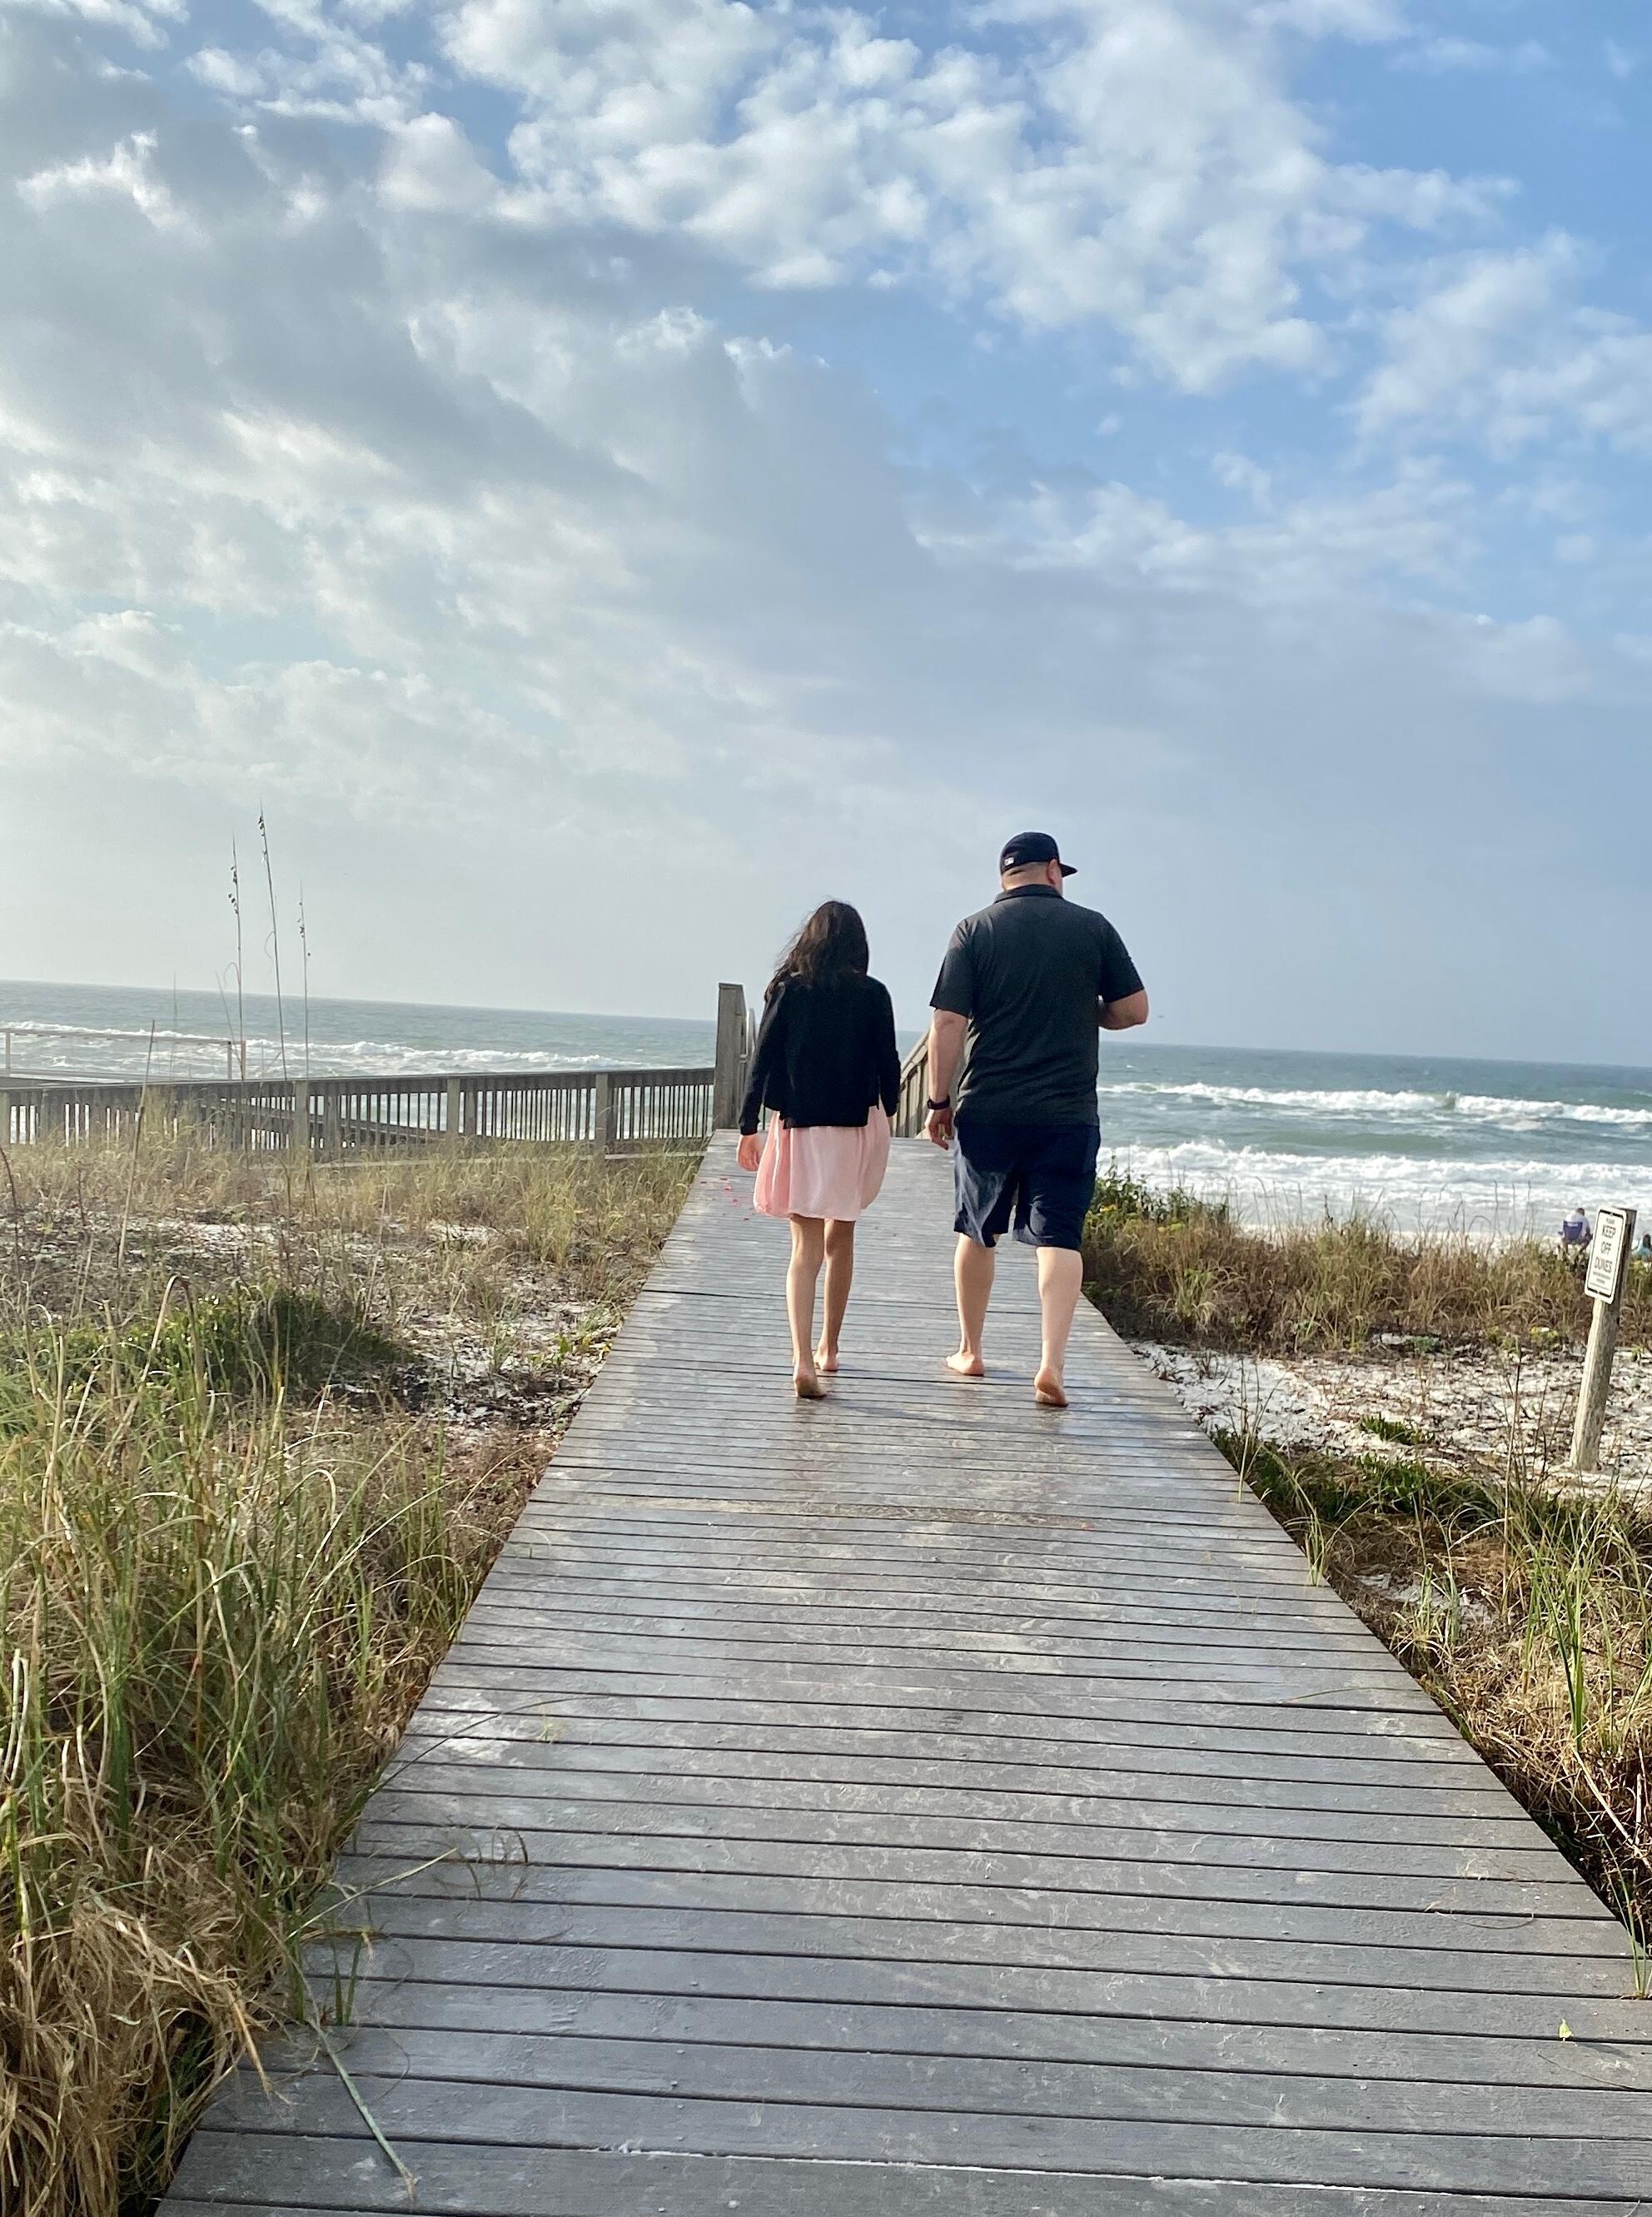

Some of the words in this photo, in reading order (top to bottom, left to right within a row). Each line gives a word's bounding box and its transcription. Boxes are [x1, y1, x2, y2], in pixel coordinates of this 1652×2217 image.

[1602, 1225, 1616, 1238] KEEP
[1600, 1241, 1611, 1255] OFF
[1595, 1257, 1612, 1273] DUNES
